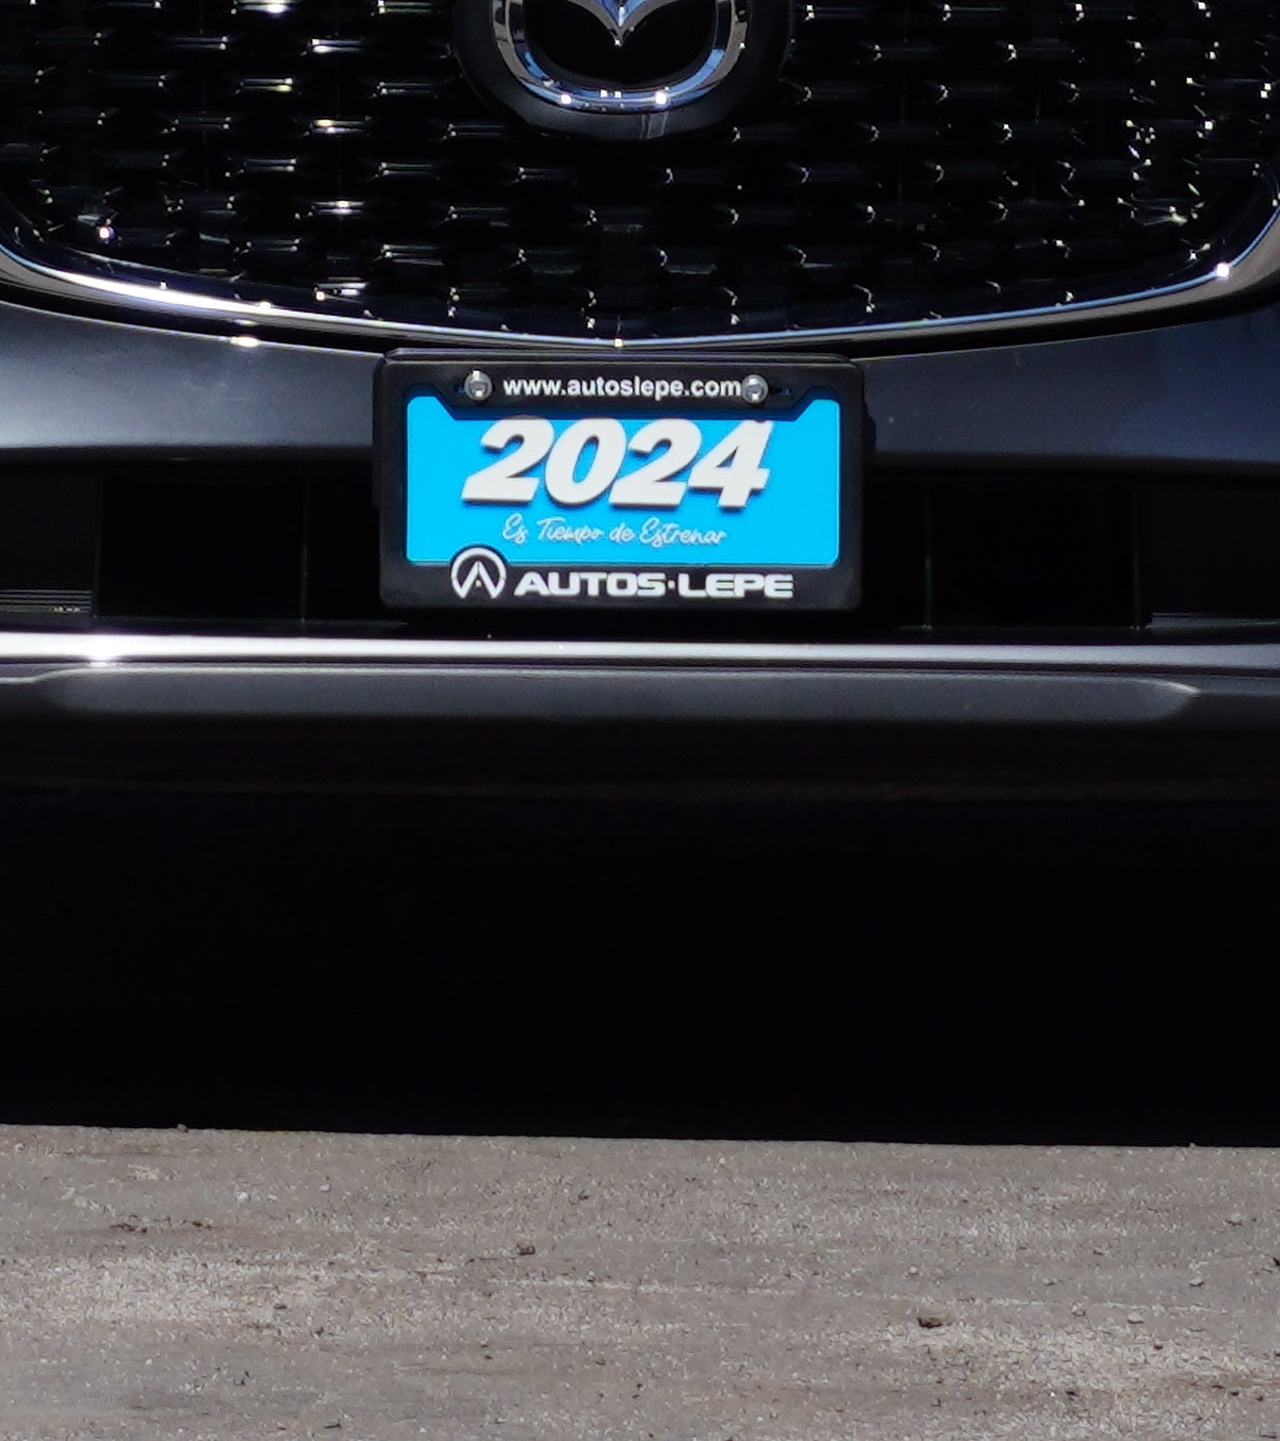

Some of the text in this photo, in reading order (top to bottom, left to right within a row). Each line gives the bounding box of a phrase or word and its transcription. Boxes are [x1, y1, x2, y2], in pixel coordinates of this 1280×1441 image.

[503, 376, 742, 402] www.autoslepe.com
[461, 417, 774, 510] 2024
[502, 513, 727, 548] Es Tiempo de Estrenar
